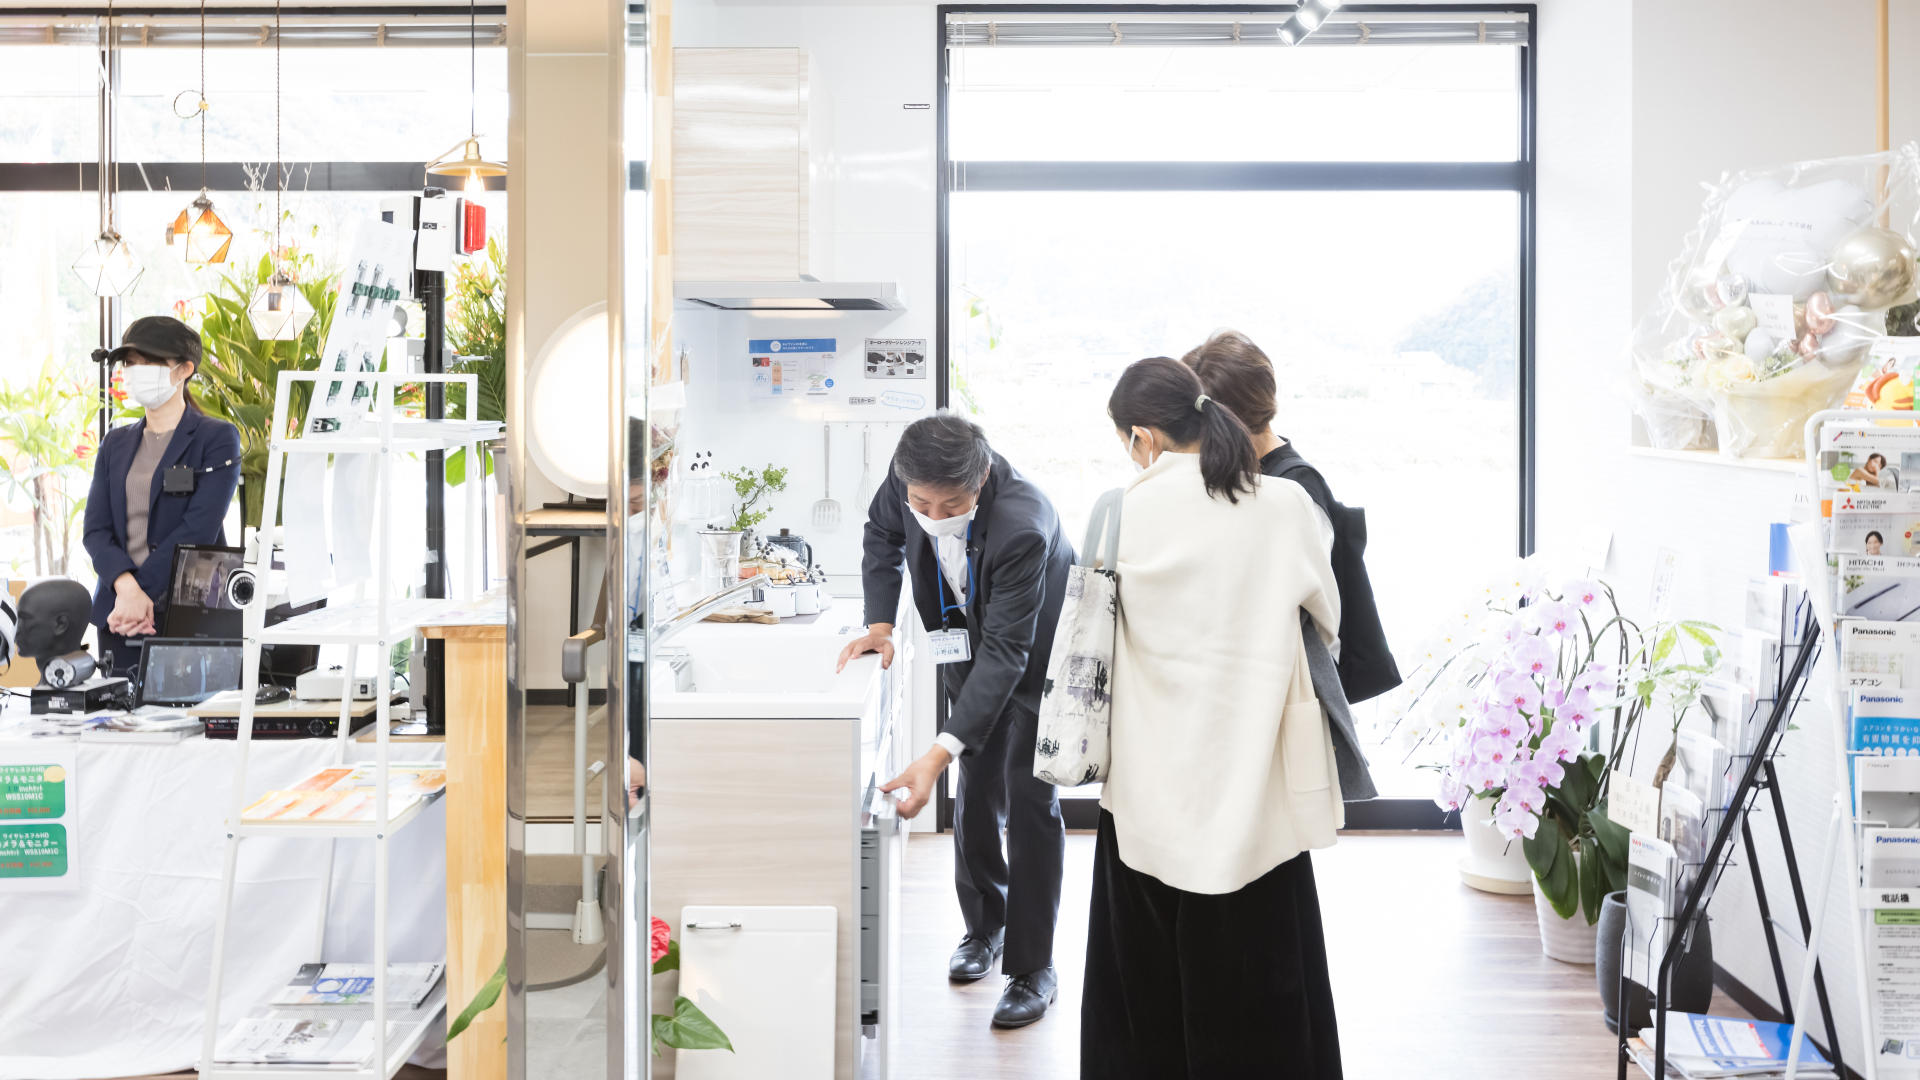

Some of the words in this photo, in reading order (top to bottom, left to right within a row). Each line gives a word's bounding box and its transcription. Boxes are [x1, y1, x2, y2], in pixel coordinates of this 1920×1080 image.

[1852, 626, 1896, 636] Panasonic
[1850, 678, 1882, 687] エアコン
[1860, 695, 1903, 703] Panasonic
[1876, 836, 1920, 844] Panasonic
[1881, 893, 1909, 903] 電話機
